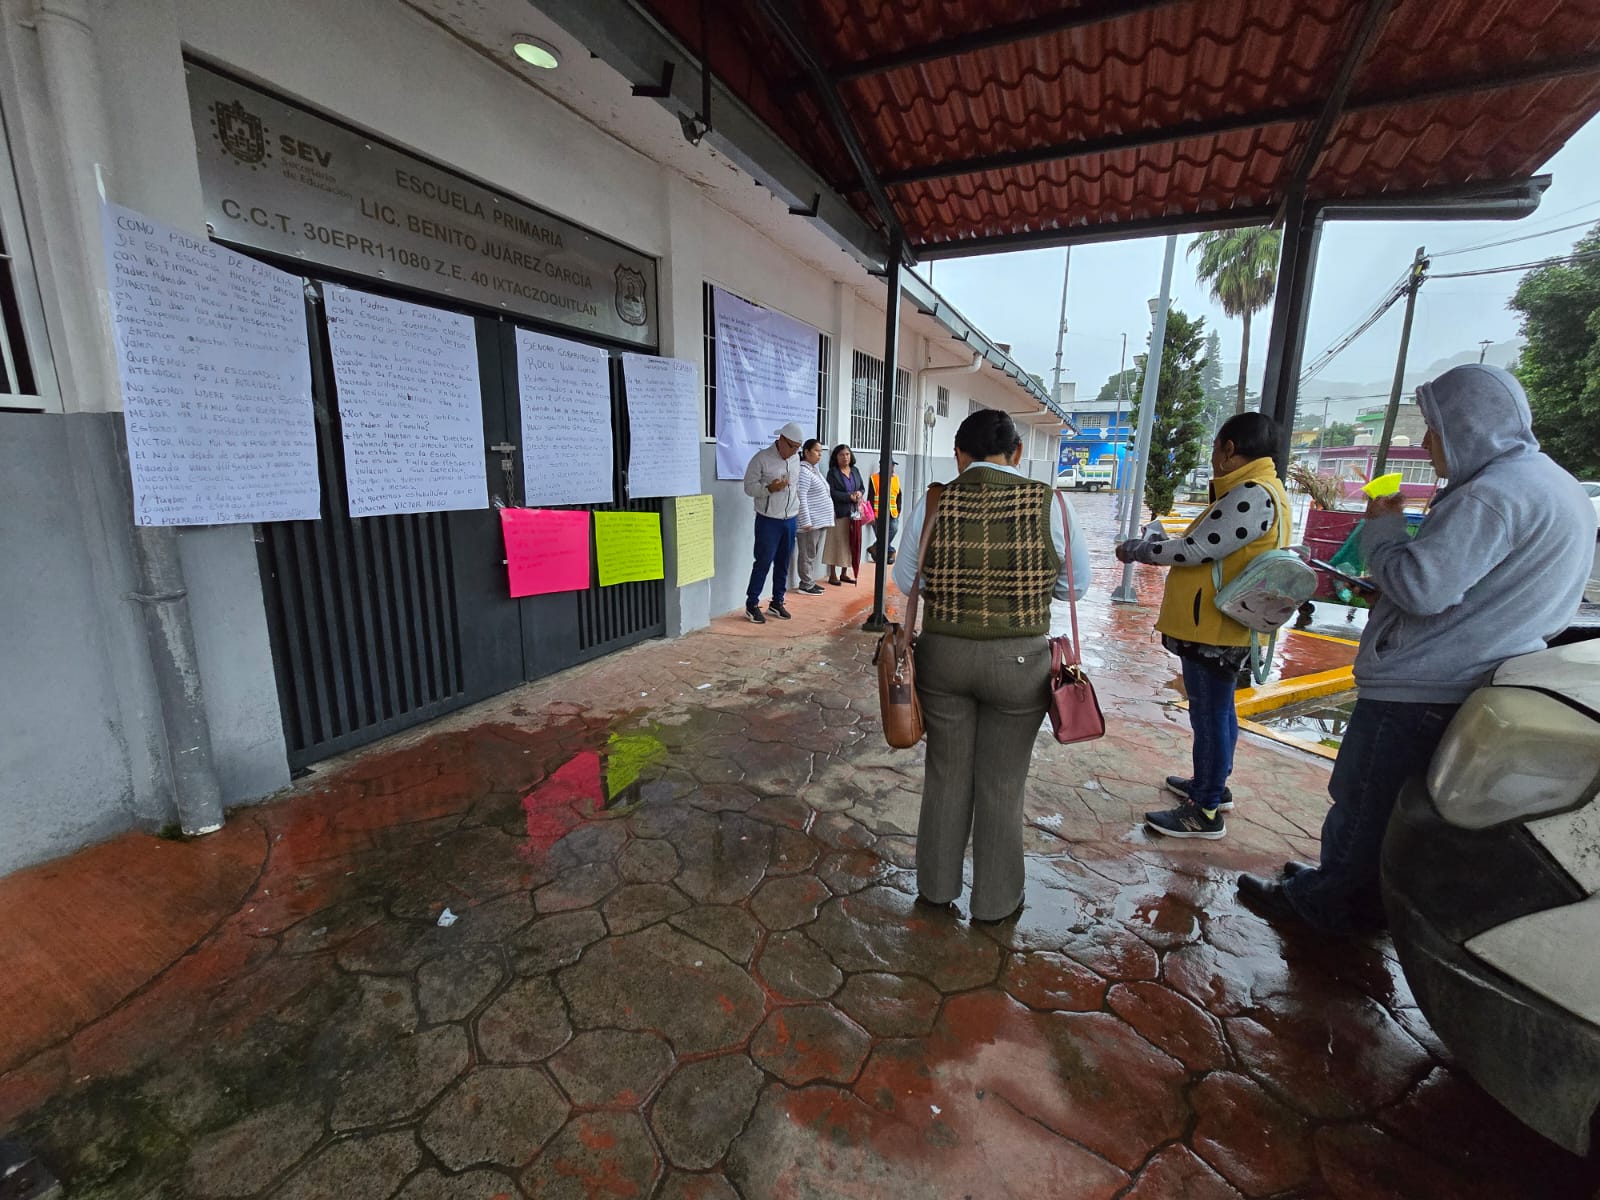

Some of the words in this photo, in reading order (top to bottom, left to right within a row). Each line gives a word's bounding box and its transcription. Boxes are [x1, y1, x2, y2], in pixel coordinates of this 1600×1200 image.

[280, 135, 331, 168] SEV
[361, 198, 400, 228] LIC.
[408, 214, 477, 250] BENITO
[482, 241, 541, 273] JUAREZ
[545, 262, 592, 289] GARCIA
[395, 169, 485, 219] ESCUELA
[493, 209, 563, 248] PRIMARIA
[169, 233, 217, 258] PADRES
[228, 255, 243, 269] DE
[221, 198, 296, 236] C.C.T.
[303, 222, 430, 271] 30EPR11080
[435, 259, 467, 281] Z.E.
[471, 271, 488, 287] 40
[493, 275, 597, 317] IXTACZOQUITLAN
